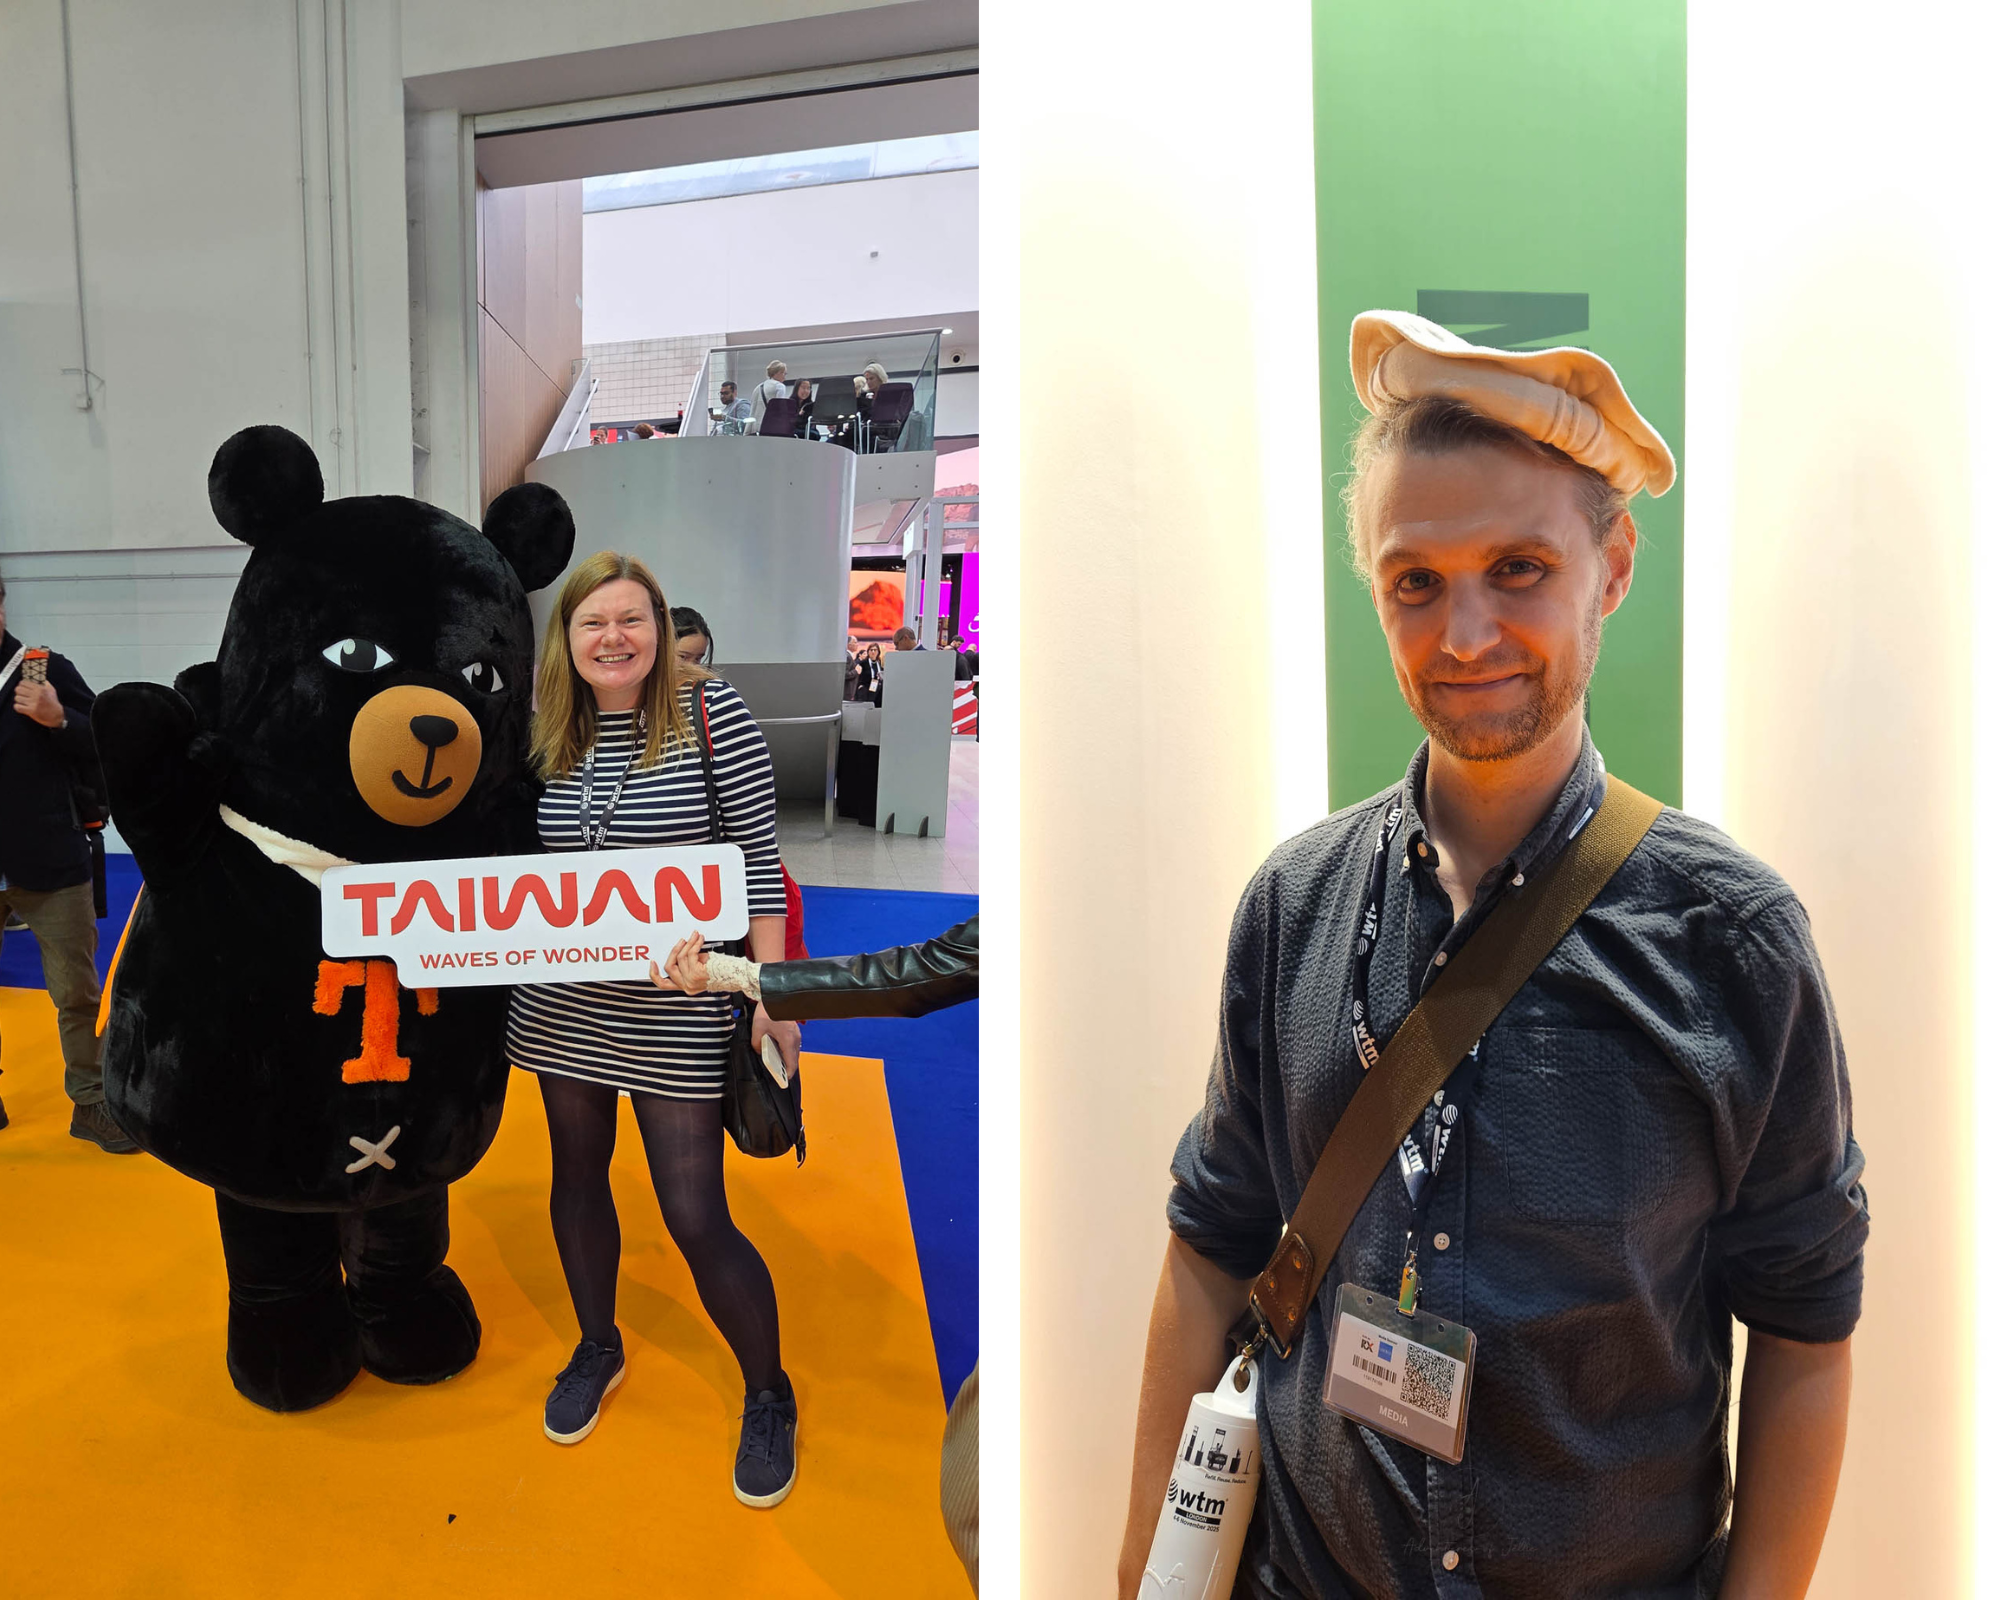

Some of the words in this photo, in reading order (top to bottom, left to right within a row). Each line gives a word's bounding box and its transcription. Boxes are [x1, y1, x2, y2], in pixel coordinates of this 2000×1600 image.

[343, 864, 723, 937] TAIWAN
[420, 951, 498, 970] WAVES
[505, 949, 535, 966] OF
[543, 944, 650, 964] WONDER
[1357, 1020, 1380, 1066] wtm
[1378, 1404, 1409, 1427] MEDIA
[1180, 1489, 1225, 1516] wtm
[1179, 1518, 1206, 1530] November
[1206, 1524, 1220, 1533] 2025
